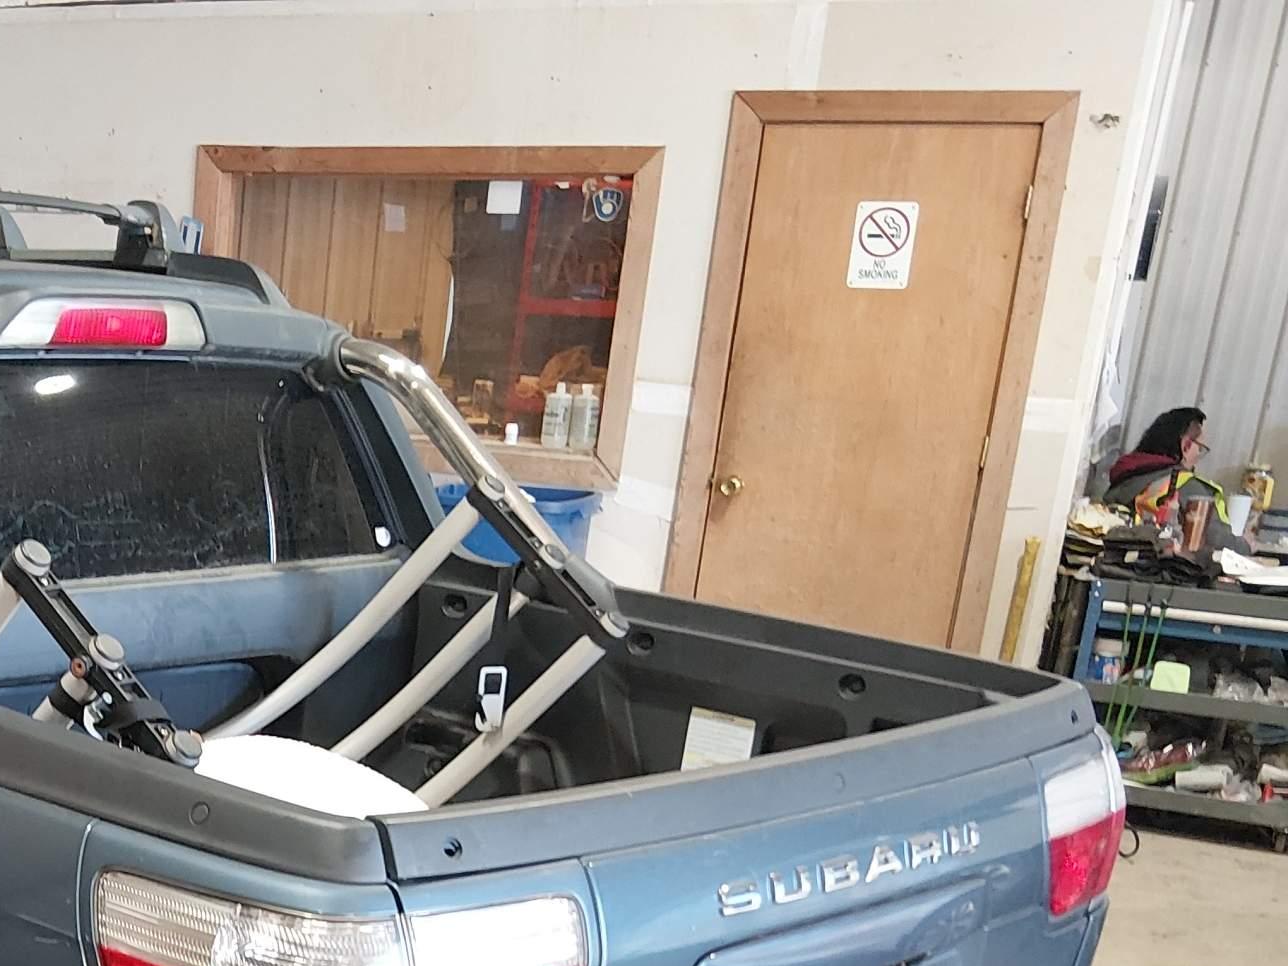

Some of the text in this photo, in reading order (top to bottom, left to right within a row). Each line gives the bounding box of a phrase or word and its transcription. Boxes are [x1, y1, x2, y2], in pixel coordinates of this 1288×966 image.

[872, 259, 887, 270] NO
[857, 269, 899, 280] SMOKING
[715, 820, 981, 917] SUBARU
